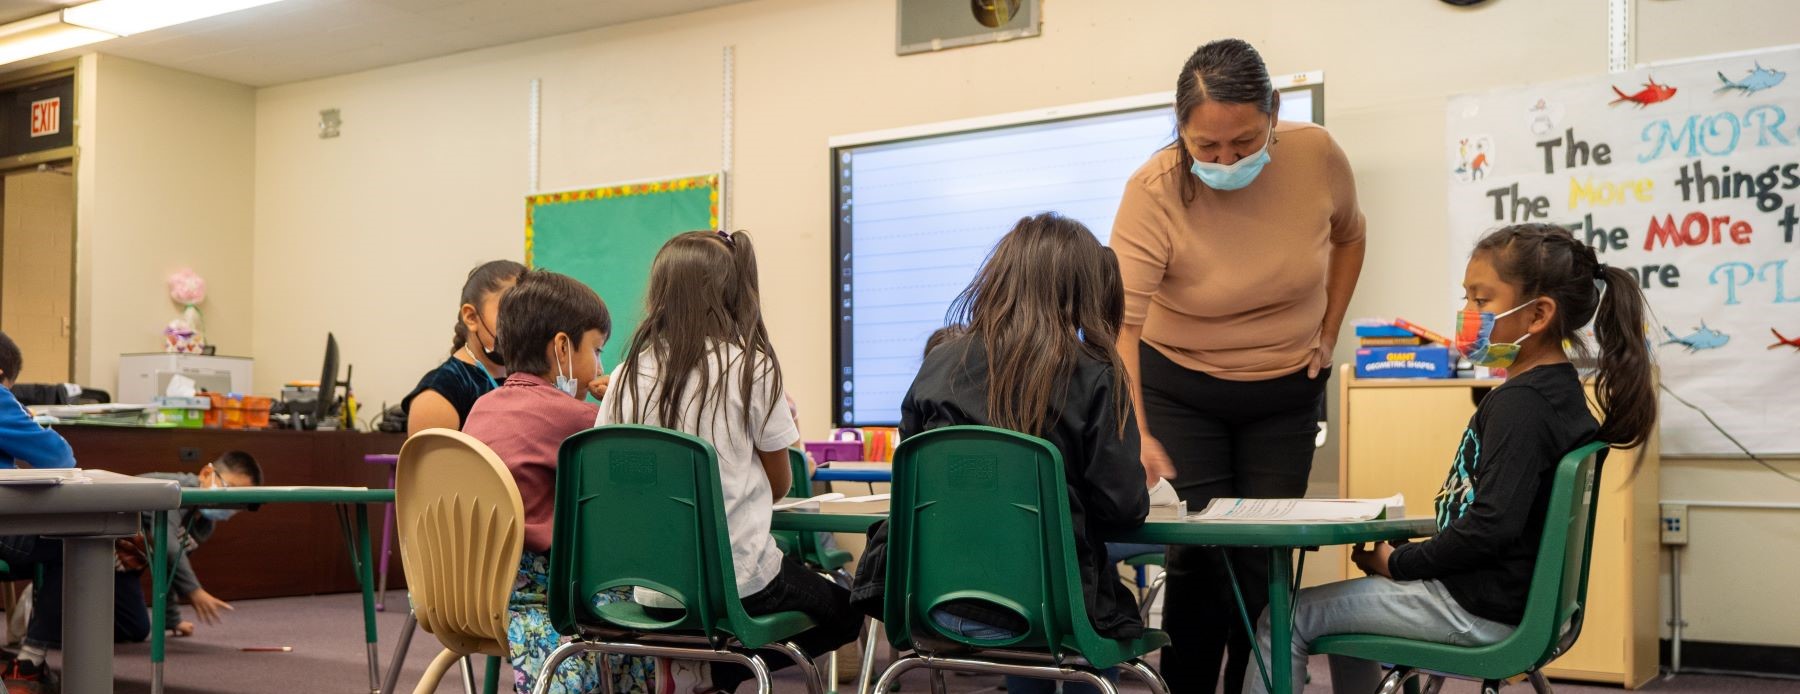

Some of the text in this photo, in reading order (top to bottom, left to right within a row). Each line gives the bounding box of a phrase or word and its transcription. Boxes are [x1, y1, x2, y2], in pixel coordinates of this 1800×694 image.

[32, 101, 59, 134] EXIT
[1536, 104, 1800, 174] The MOR
[1486, 160, 1800, 223] The More things
